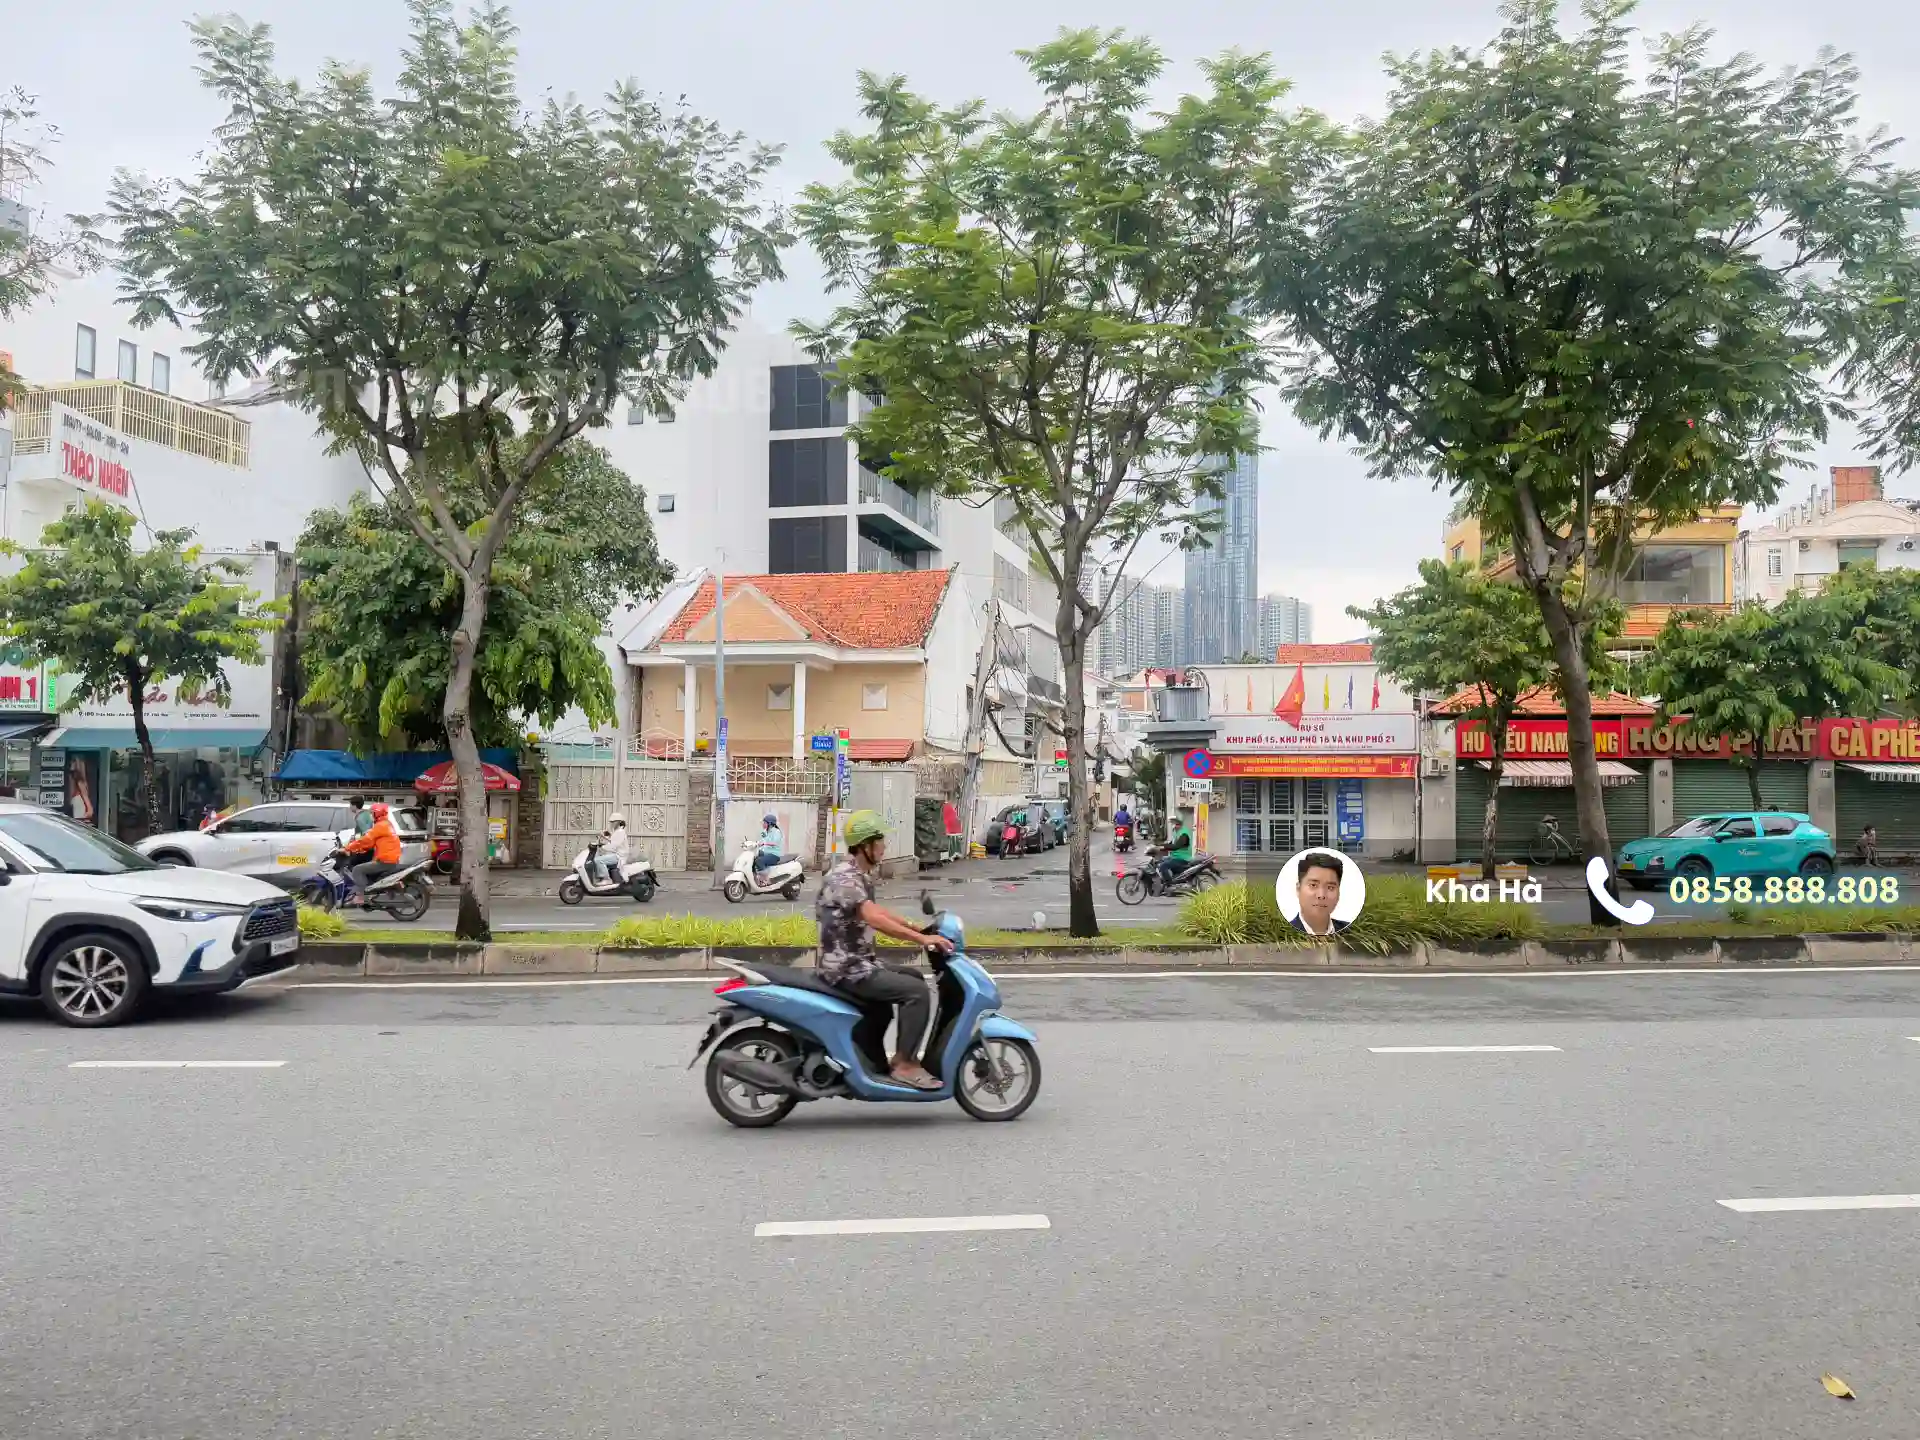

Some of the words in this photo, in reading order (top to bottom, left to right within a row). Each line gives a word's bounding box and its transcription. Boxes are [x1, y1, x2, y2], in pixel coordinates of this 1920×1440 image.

[62, 441, 95, 483] THẢO
[98, 457, 130, 498] NHIÊN
[1226, 735, 1244, 744] KHU
[1246, 733, 1263, 744] PHỐ
[1279, 735, 1298, 744] KHU
[1332, 733, 1344, 744] VÀ
[1345, 735, 1363, 744] KHU
[1366, 733, 1384, 744] PHỐ
[1385, 735, 1395, 744] 21
[1530, 731, 1568, 753] NAM
[1830, 721, 1868, 757] CÀ
[291, 856, 308, 865] 50K
